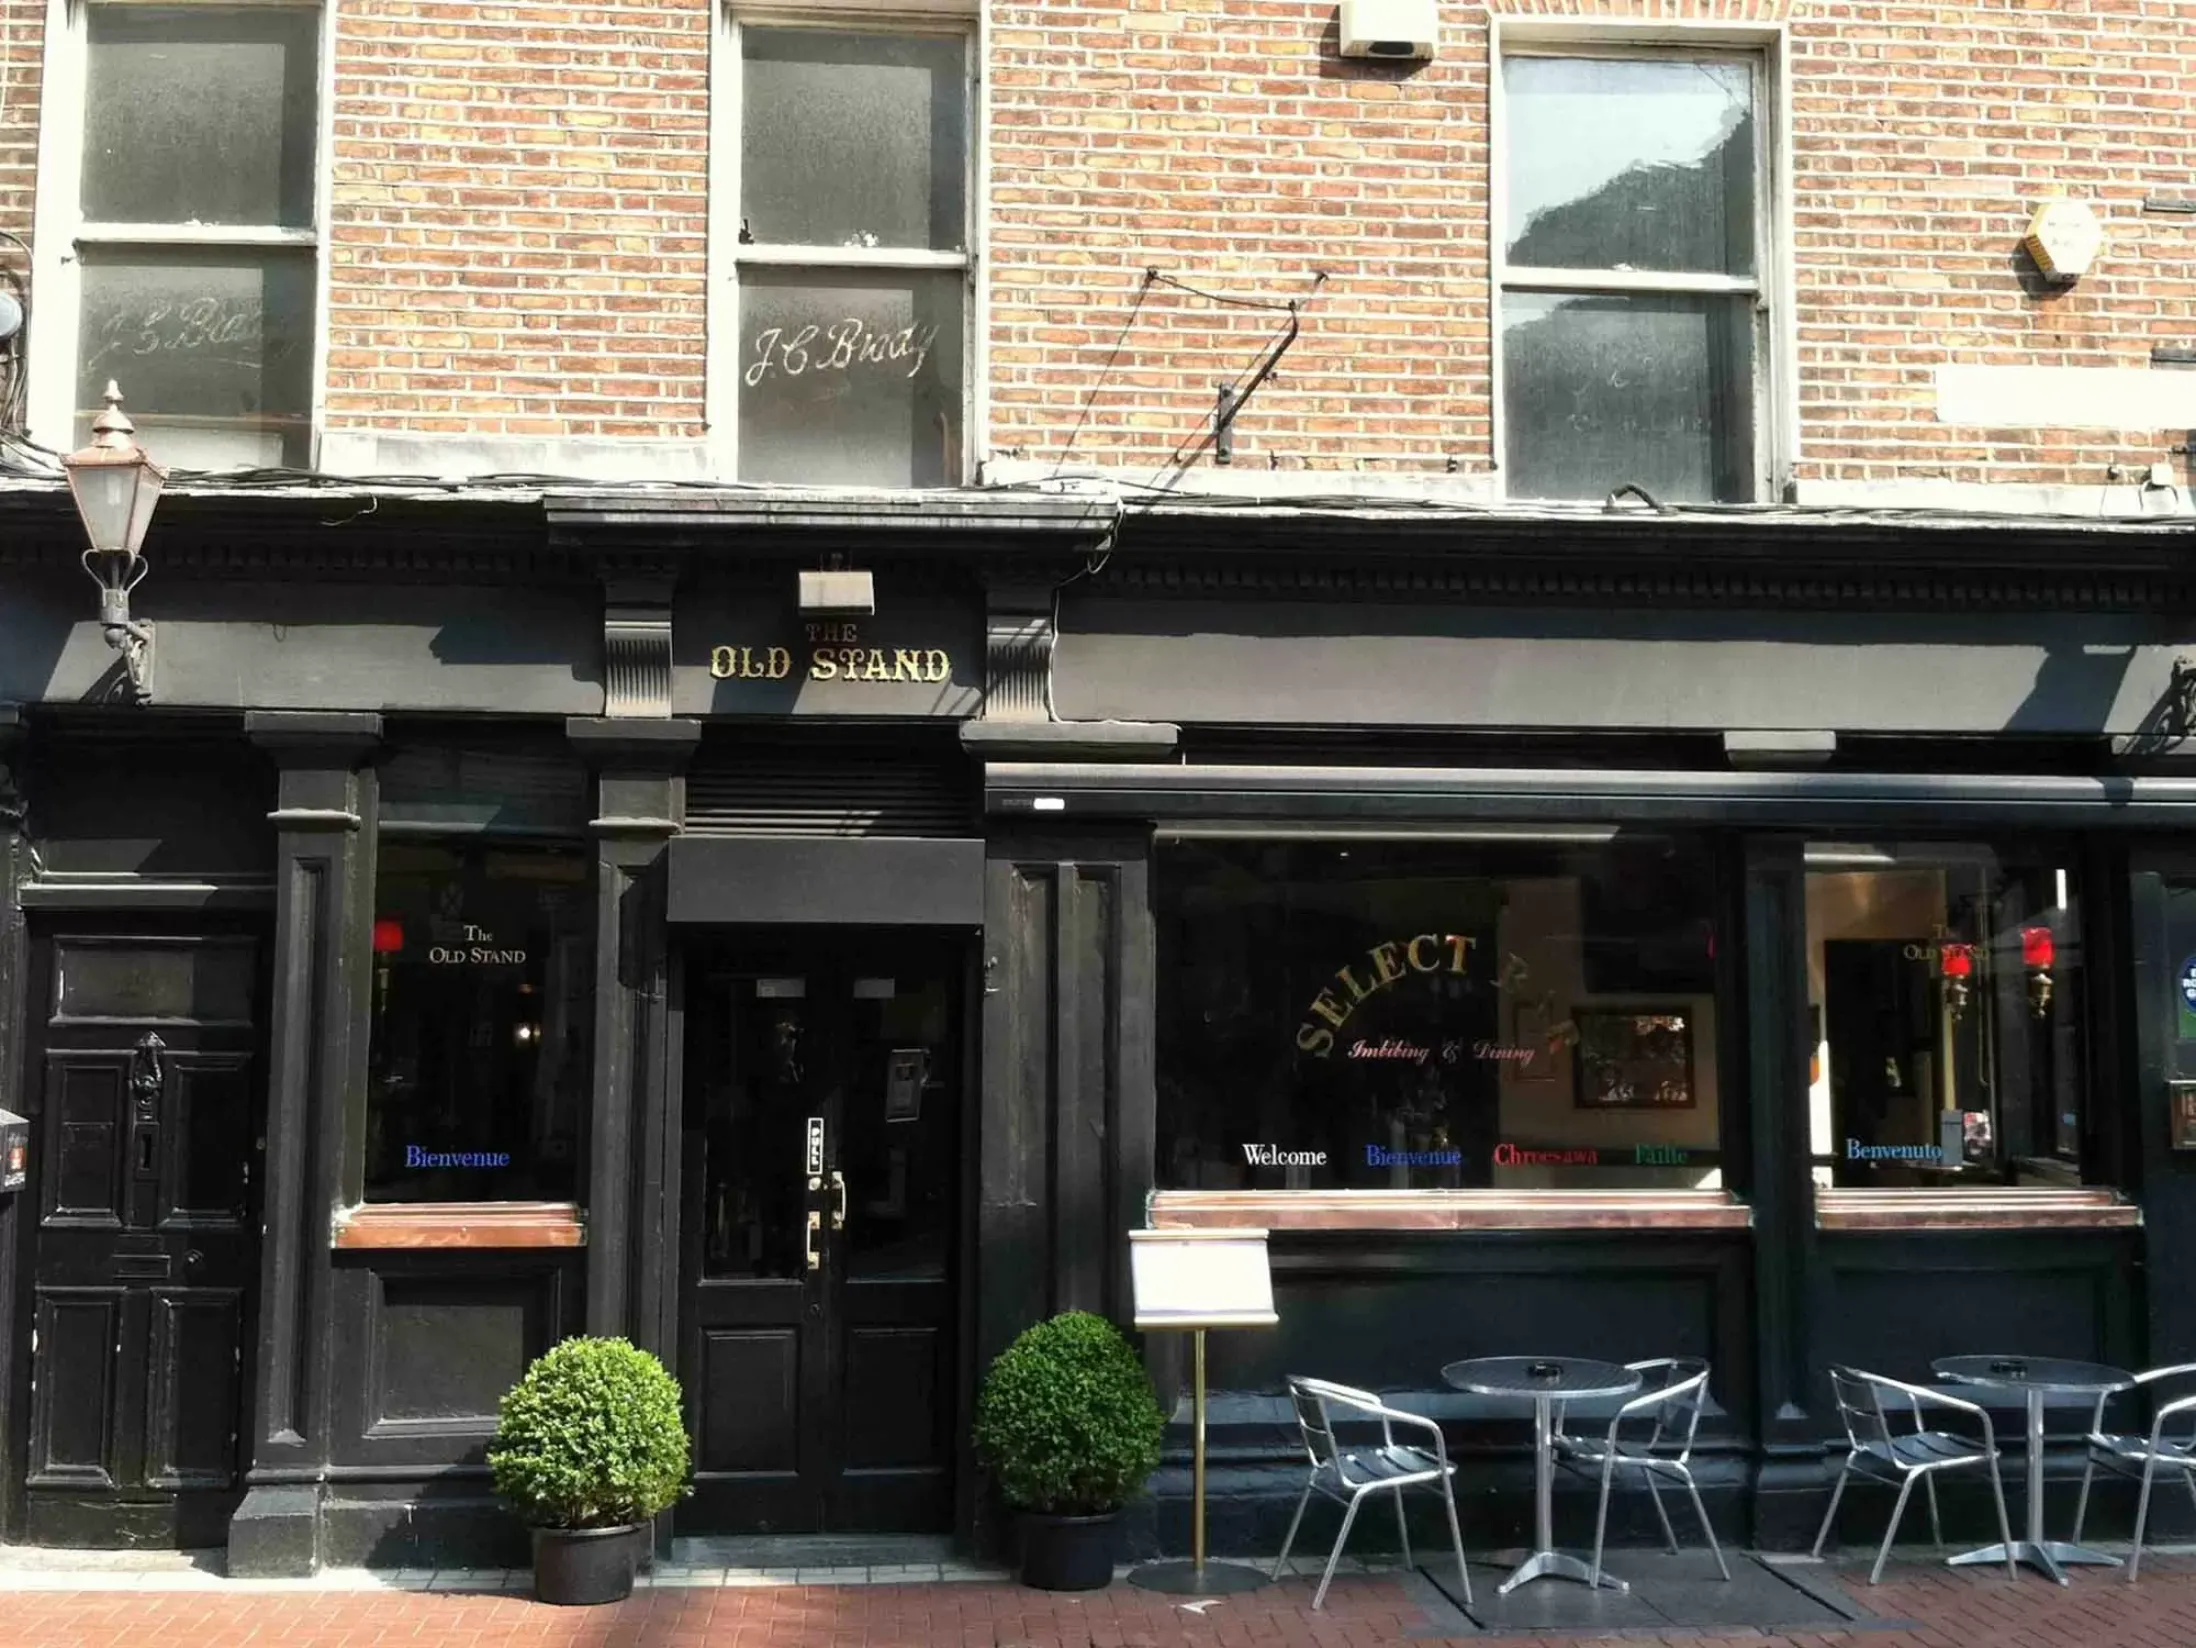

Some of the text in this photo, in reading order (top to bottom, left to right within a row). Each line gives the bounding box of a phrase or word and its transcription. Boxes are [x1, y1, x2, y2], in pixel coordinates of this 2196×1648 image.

[816, 317, 940, 378] Brady
[805, 623, 858, 643] THE
[710, 645, 951, 683] OLD STAND
[1296, 933, 1477, 1059] SELECT
[1347, 1039, 1430, 1065] Imbibing
[1472, 1042, 1536, 1067] Dining
[404, 1143, 512, 1168] Bienvenue
[811, 1127, 821, 1166] PULL
[1242, 1143, 1328, 1167] Welcome
[1366, 1144, 1463, 1168] Bienvenue
[1846, 1138, 1942, 1160] Benvenuto
